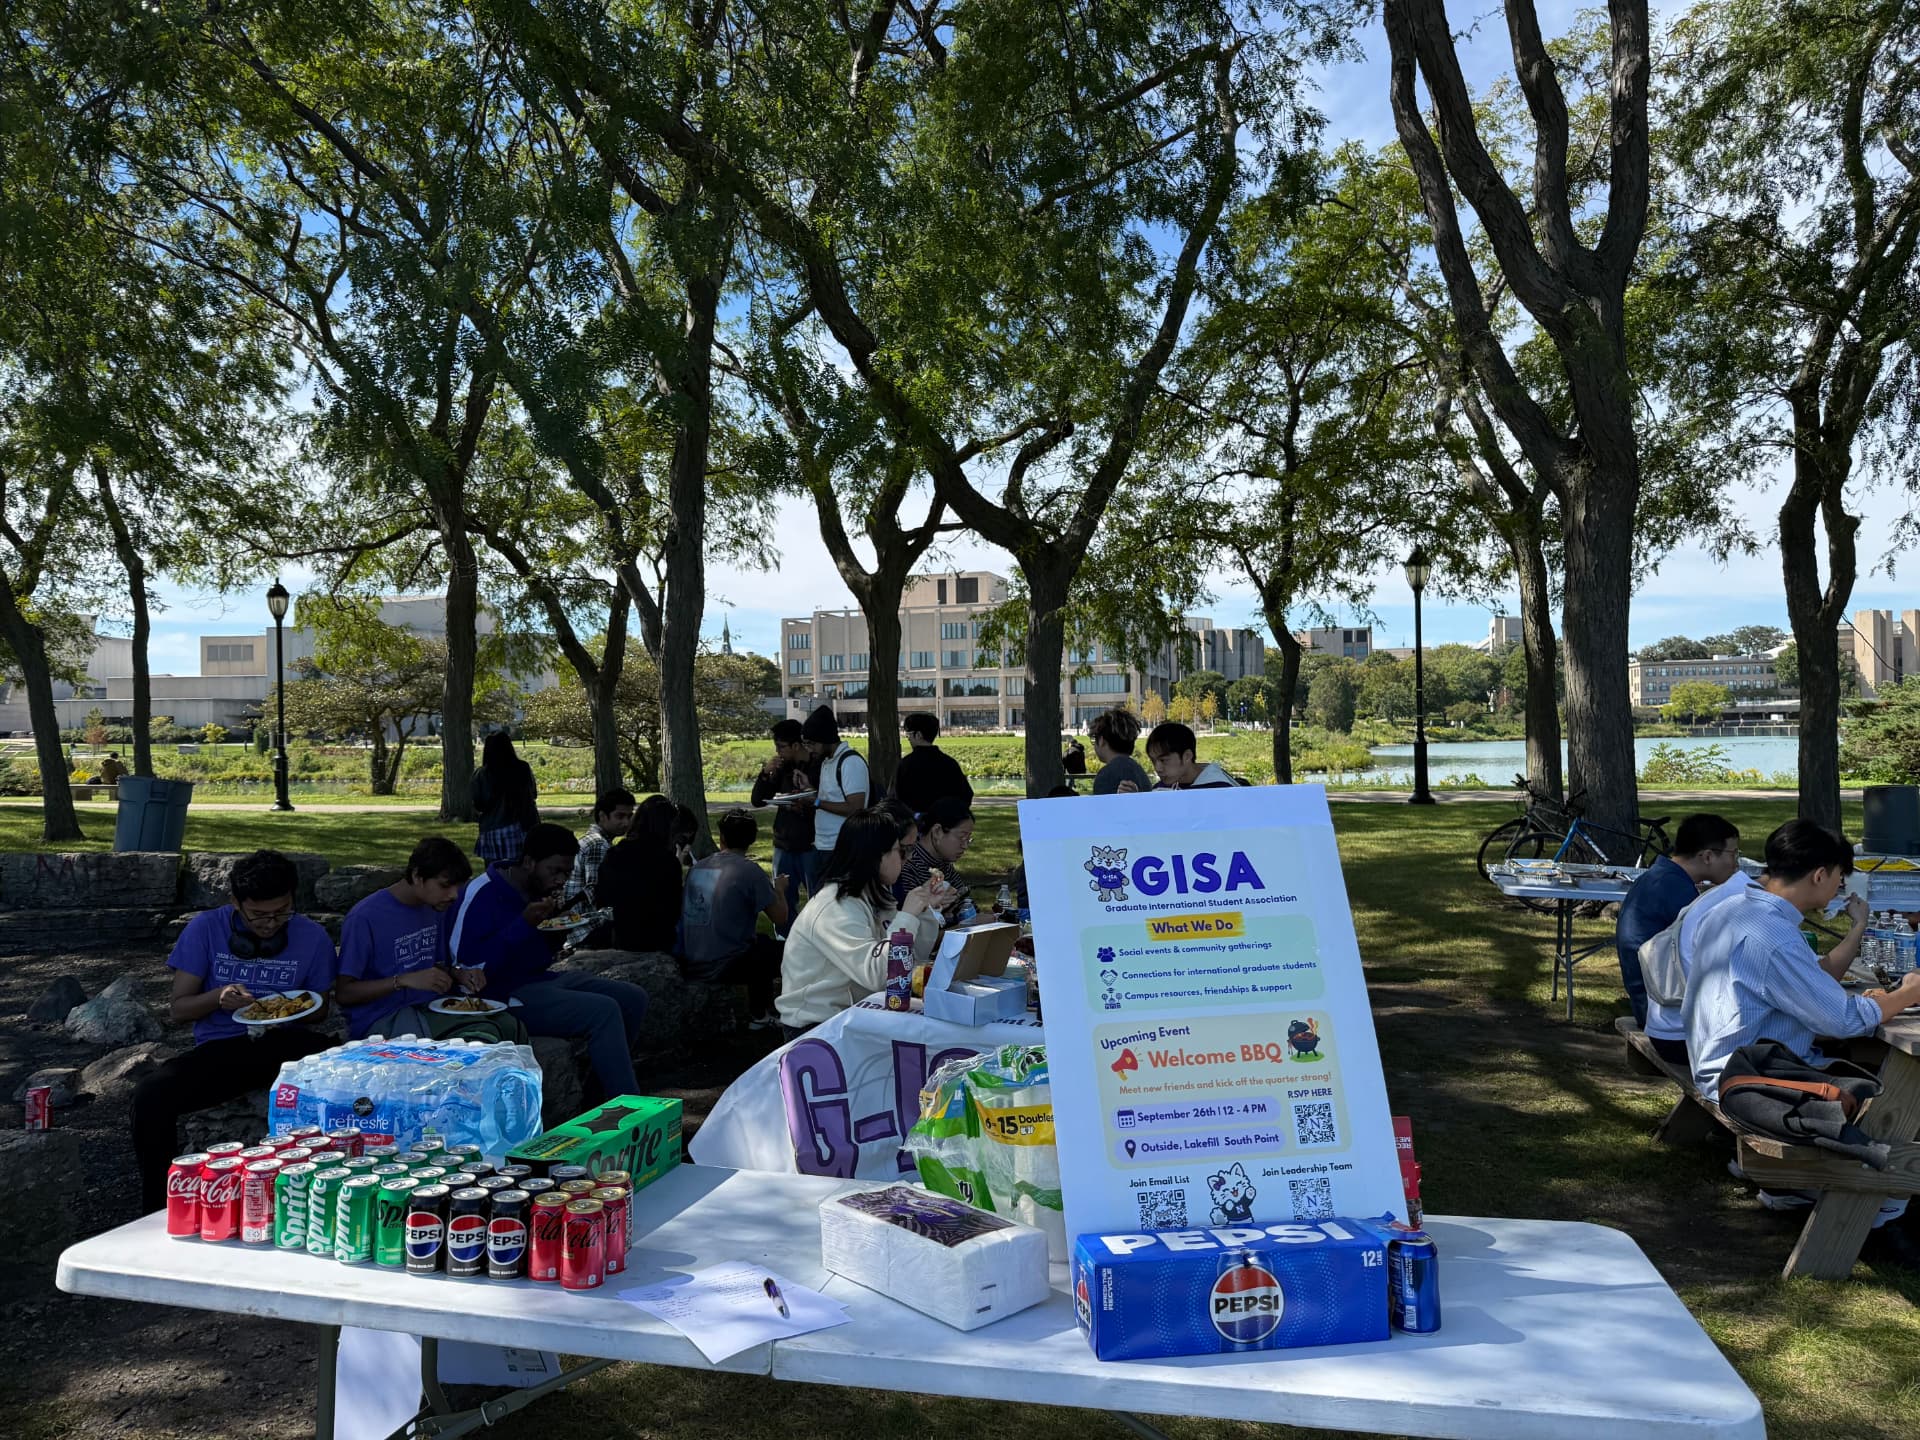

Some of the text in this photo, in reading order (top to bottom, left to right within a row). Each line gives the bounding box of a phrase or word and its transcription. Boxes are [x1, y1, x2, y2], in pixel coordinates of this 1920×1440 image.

[1131, 851, 1266, 896] GISA
[1105, 894, 1298, 913] Graduate International Student Association
[1152, 919, 1233, 934] What We Do
[1119, 941, 1272, 956] Social events & community gatherings
[240, 968, 248, 976] N
[260, 970, 268, 978] N
[1121, 961, 1317, 979] Connections for international graduate students
[1124, 982, 1293, 1001] Campus resources, friendships & support
[1100, 1025, 1190, 1050] Upcoming Event
[1147, 1042, 1283, 1069] Welcome BBQ
[1119, 1086, 1142, 1095] Meet
[1164, 1082, 1195, 1092] friends
[1196, 1080, 1214, 1089] and
[1215, 1078, 1234, 1087] kick
[1234, 1077, 1249, 1087] off
[1249, 1076, 1264, 1085] the
[1265, 1075, 1299, 1086] quarter
[1300, 1071, 1332, 1084] strong!
[277, 1087, 297, 1102] 35
[1288, 1088, 1333, 1099] RSVP HERE
[1137, 1109, 1191, 1124] September
[1193, 1107, 1217, 1118] 26th
[1222, 1105, 1235, 1115] 12
[1242, 1104, 1249, 1114] 4
[1251, 1103, 1267, 1113] PM
[1141, 1132, 1279, 1153] Outside, Lakefill South Point
[1262, 1162, 1353, 1177] Join Leadership Team
[168, 1170, 201, 1192] Coca
[1129, 1175, 1190, 1188] Join Email List
[281, 1173, 307, 1248] Sprite
[449, 1230, 487, 1243] PEPSI
[488, 1233, 525, 1246] PEPSI
[1101, 1221, 1355, 1255] PEPSI
[1361, 1250, 1376, 1267] 12
[1214, 1293, 1280, 1314] PEPSI
